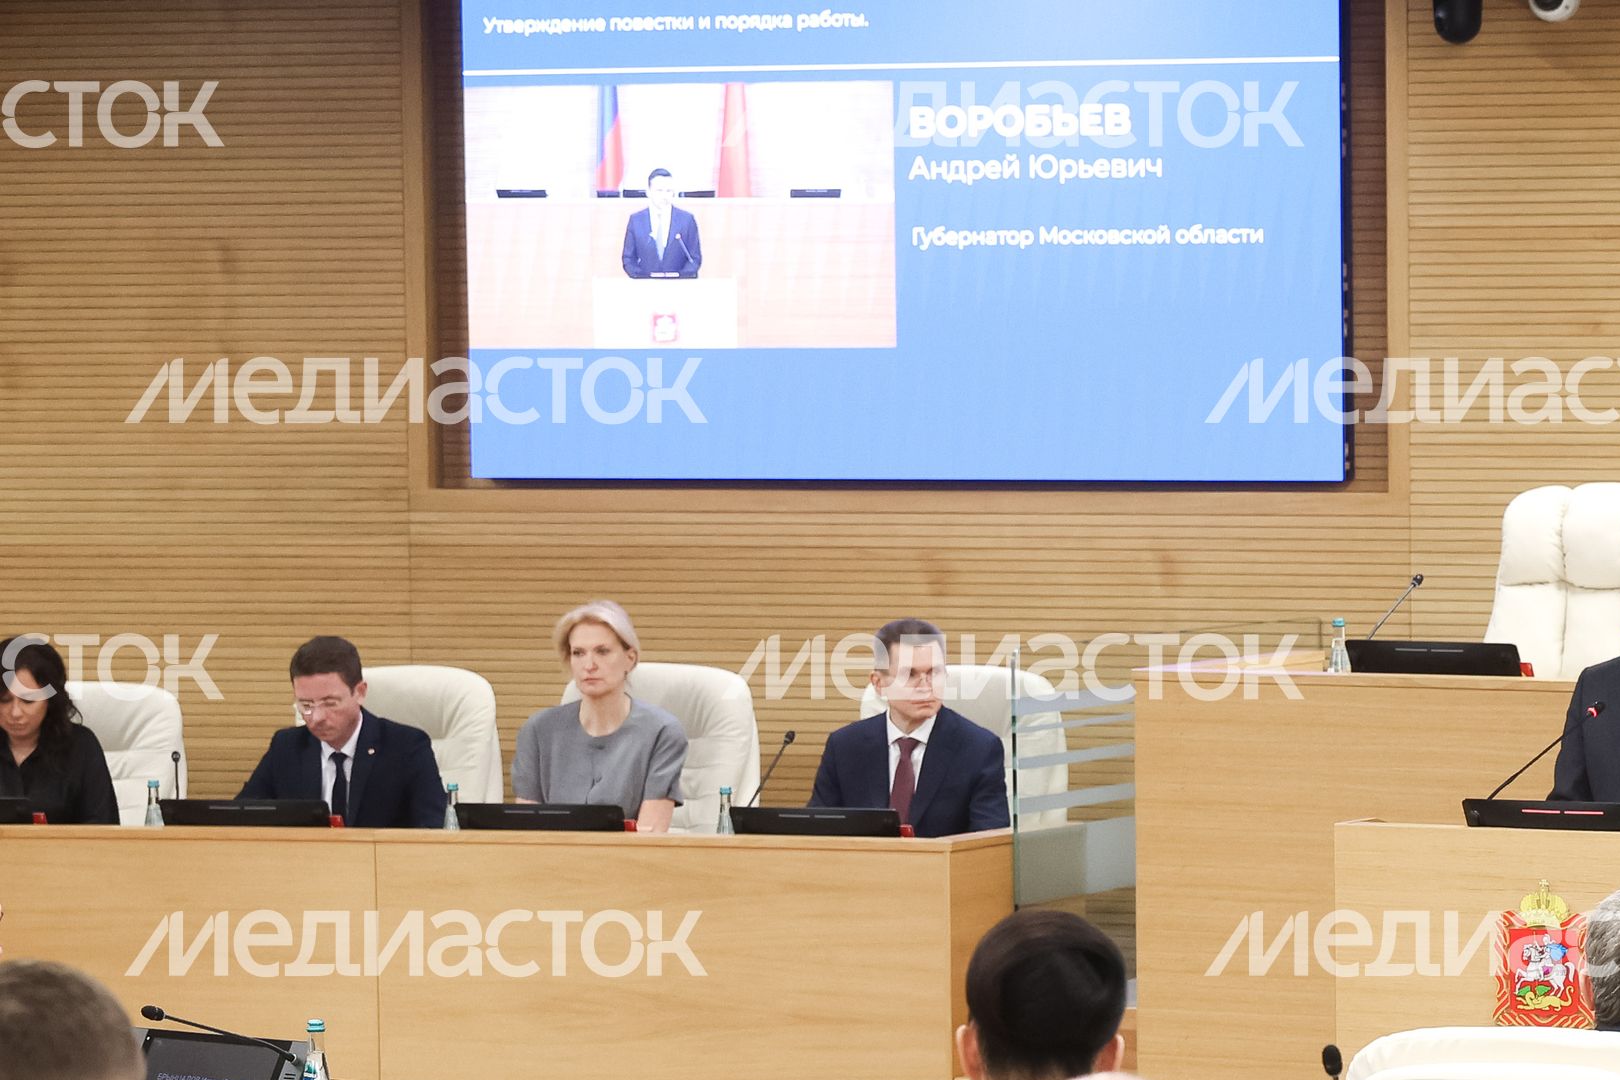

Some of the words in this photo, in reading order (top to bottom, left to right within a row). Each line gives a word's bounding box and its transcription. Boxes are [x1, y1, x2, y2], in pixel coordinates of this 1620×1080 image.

[483, 16, 606, 36] Утверждение
[609, 16, 694, 32] повестки
[699, 17, 711, 30] и
[715, 14, 793, 32] порядка
[797, 10, 870, 30] работы.
[909, 103, 1132, 138] ВОРОБЬЕВ
[908, 155, 1020, 184] Андрей
[1029, 156, 1163, 184] Юрьевич
[912, 225, 1034, 250] Губернатор
[1039, 224, 1170, 246] Московской
[1175, 224, 1265, 245] области
